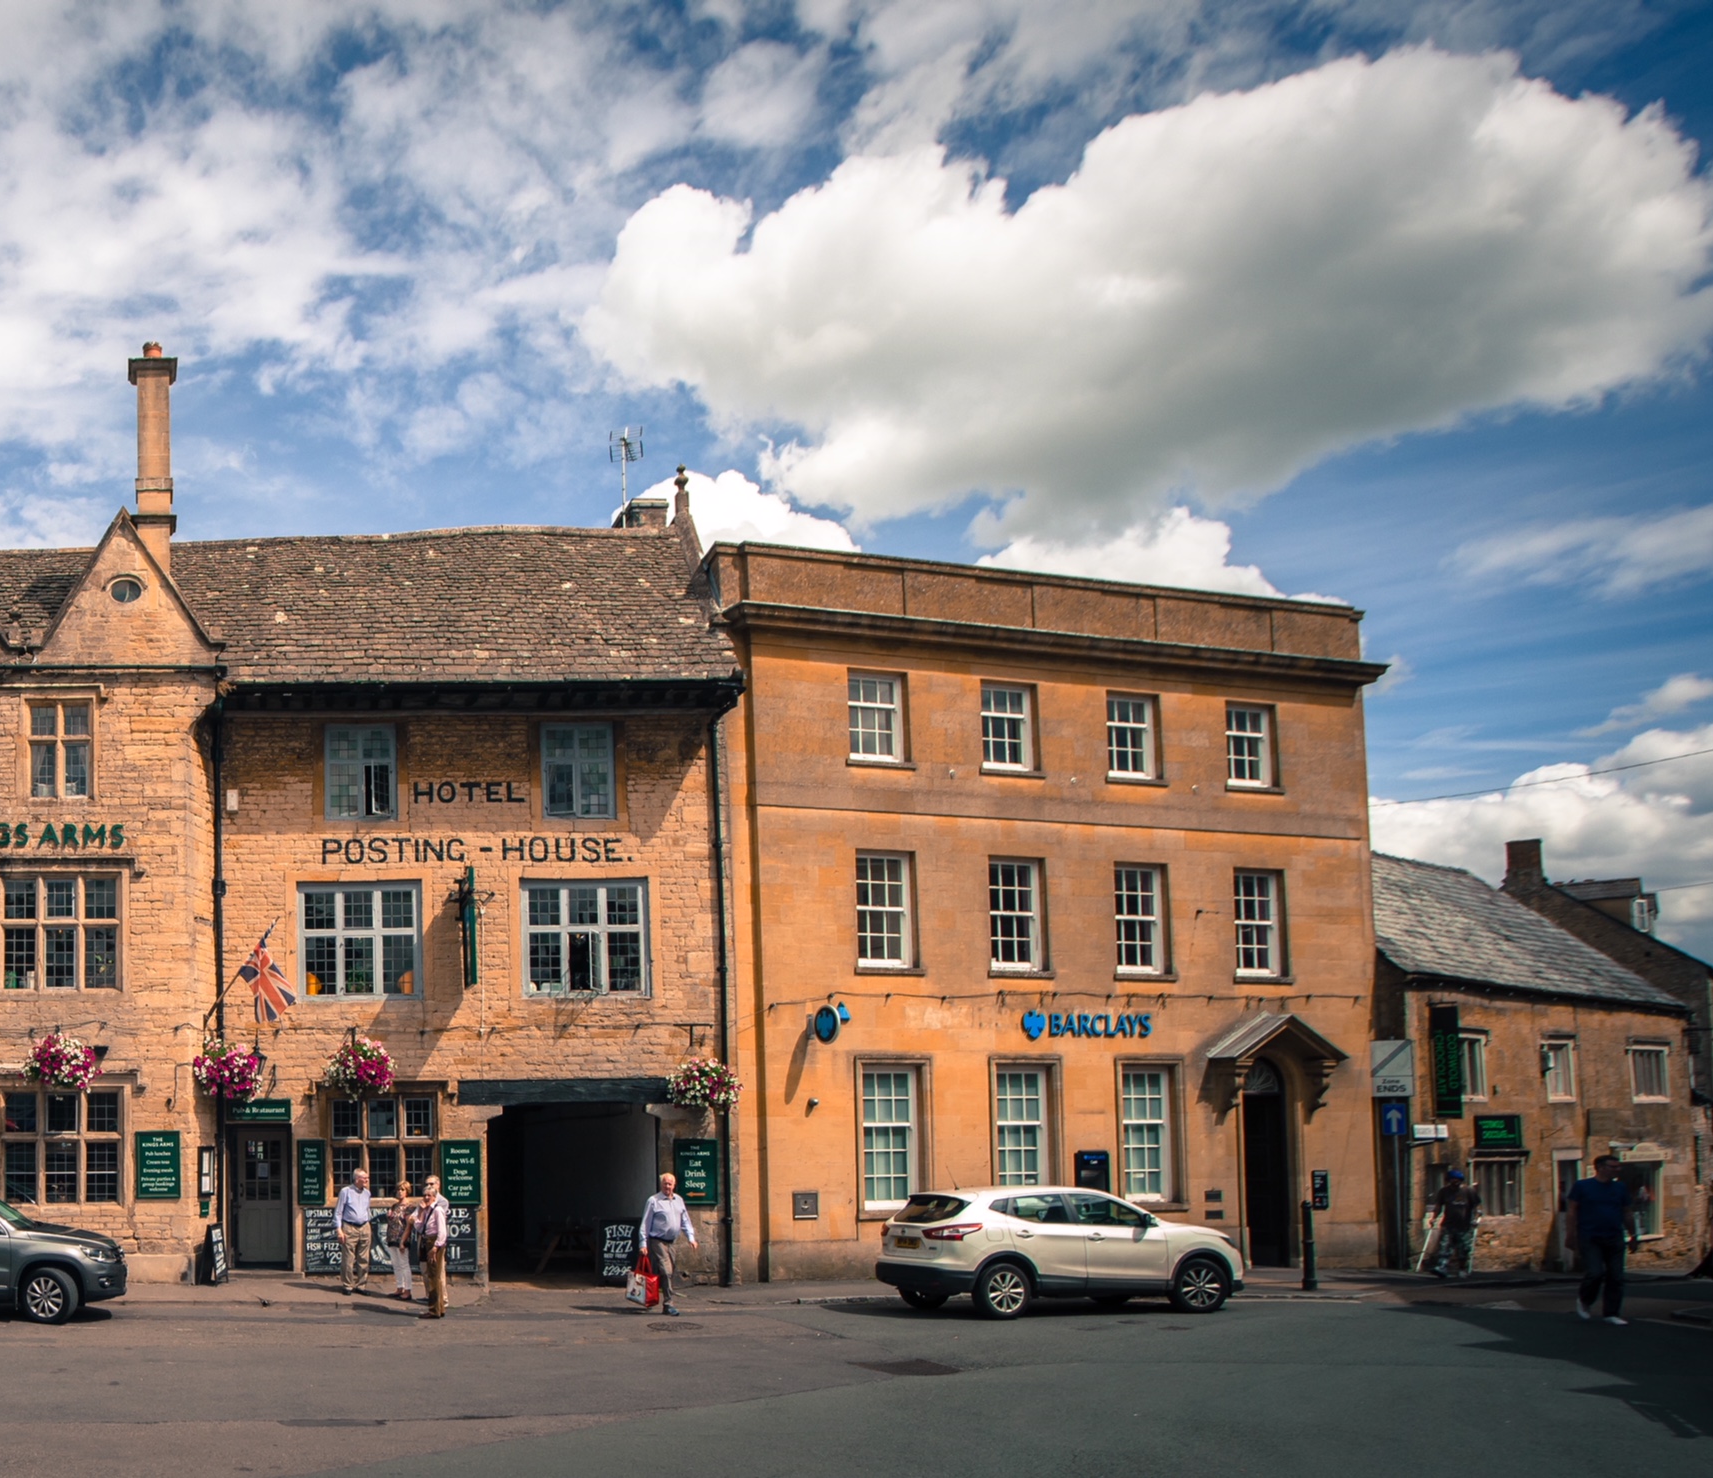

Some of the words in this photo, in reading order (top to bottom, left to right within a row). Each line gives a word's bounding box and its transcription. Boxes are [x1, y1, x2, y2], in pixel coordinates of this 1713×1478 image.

[413, 781, 525, 803] HOTEL
[39, 823, 125, 848] ARMS
[322, 837, 466, 864] POSTING
[1050, 1013, 1154, 1037] BARCLAYS
[1446, 1034, 1460, 1090] COTSWOLD
[1376, 1084, 1407, 1093] ENDS
[251, 1106, 286, 1114] Restaurant
[684, 1170, 706, 1178] Drink
[684, 1180, 706, 1189] Sleep
[305, 1209, 333, 1218] UPSTAIRS
[604, 1224, 635, 1239] FISH
[306, 1242, 322, 1251] FISH
[323, 1242, 340, 1251] FIZZ
[603, 1240, 633, 1253] FIZZ
